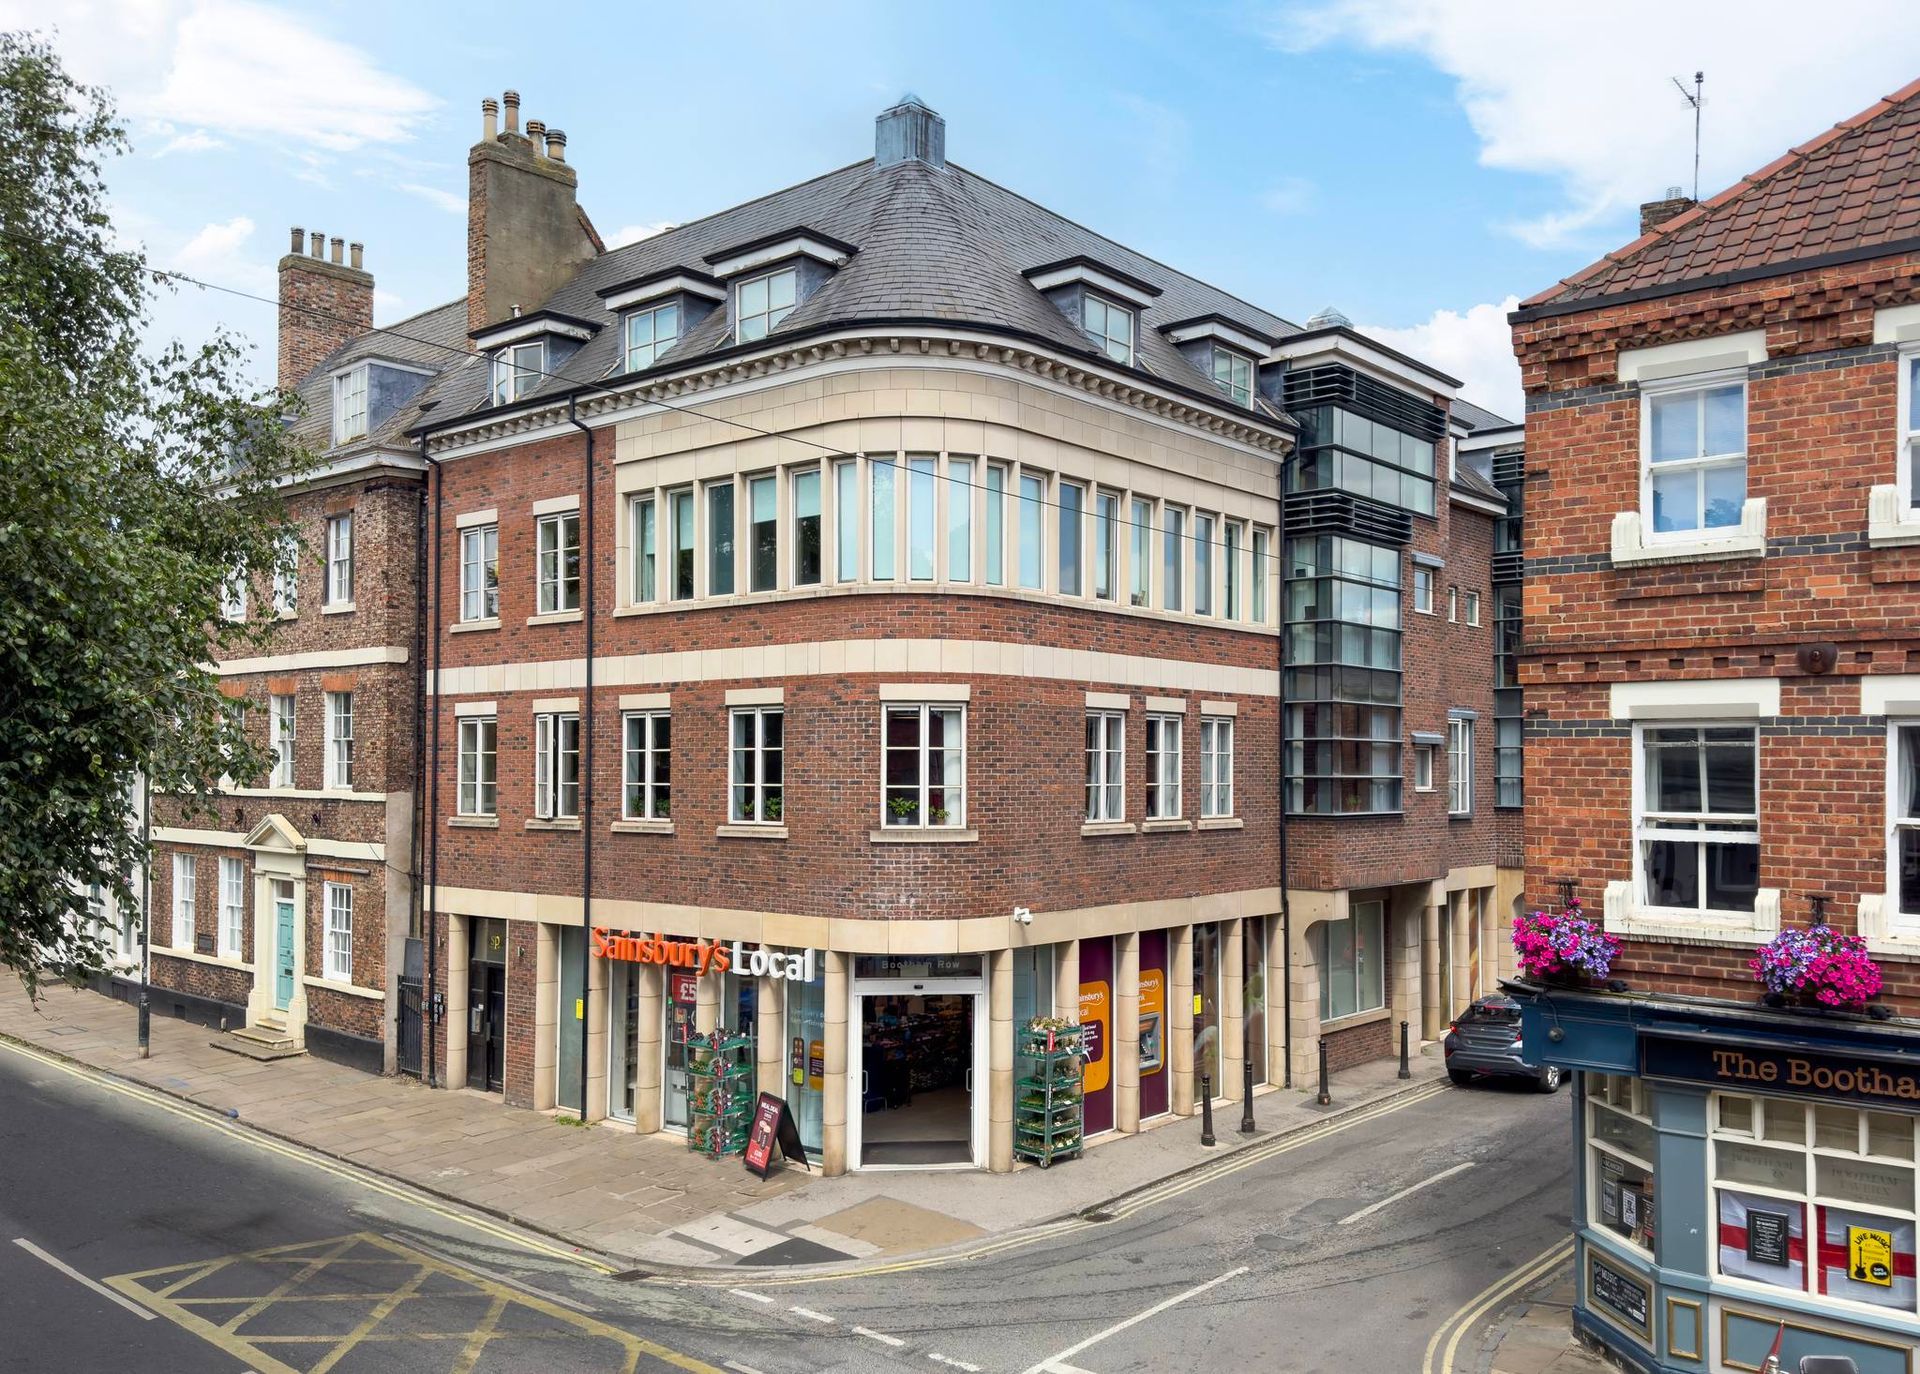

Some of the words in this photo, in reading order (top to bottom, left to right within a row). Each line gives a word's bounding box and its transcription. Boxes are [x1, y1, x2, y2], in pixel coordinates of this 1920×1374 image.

[591, 926, 731, 977] Sainsbury's
[732, 941, 816, 983] Local
[937, 960, 960, 969] Row
[1712, 1050, 1778, 1082] The
[1854, 1233, 1868, 1245] LIVE
[1870, 1233, 1890, 1250] MUSIC
